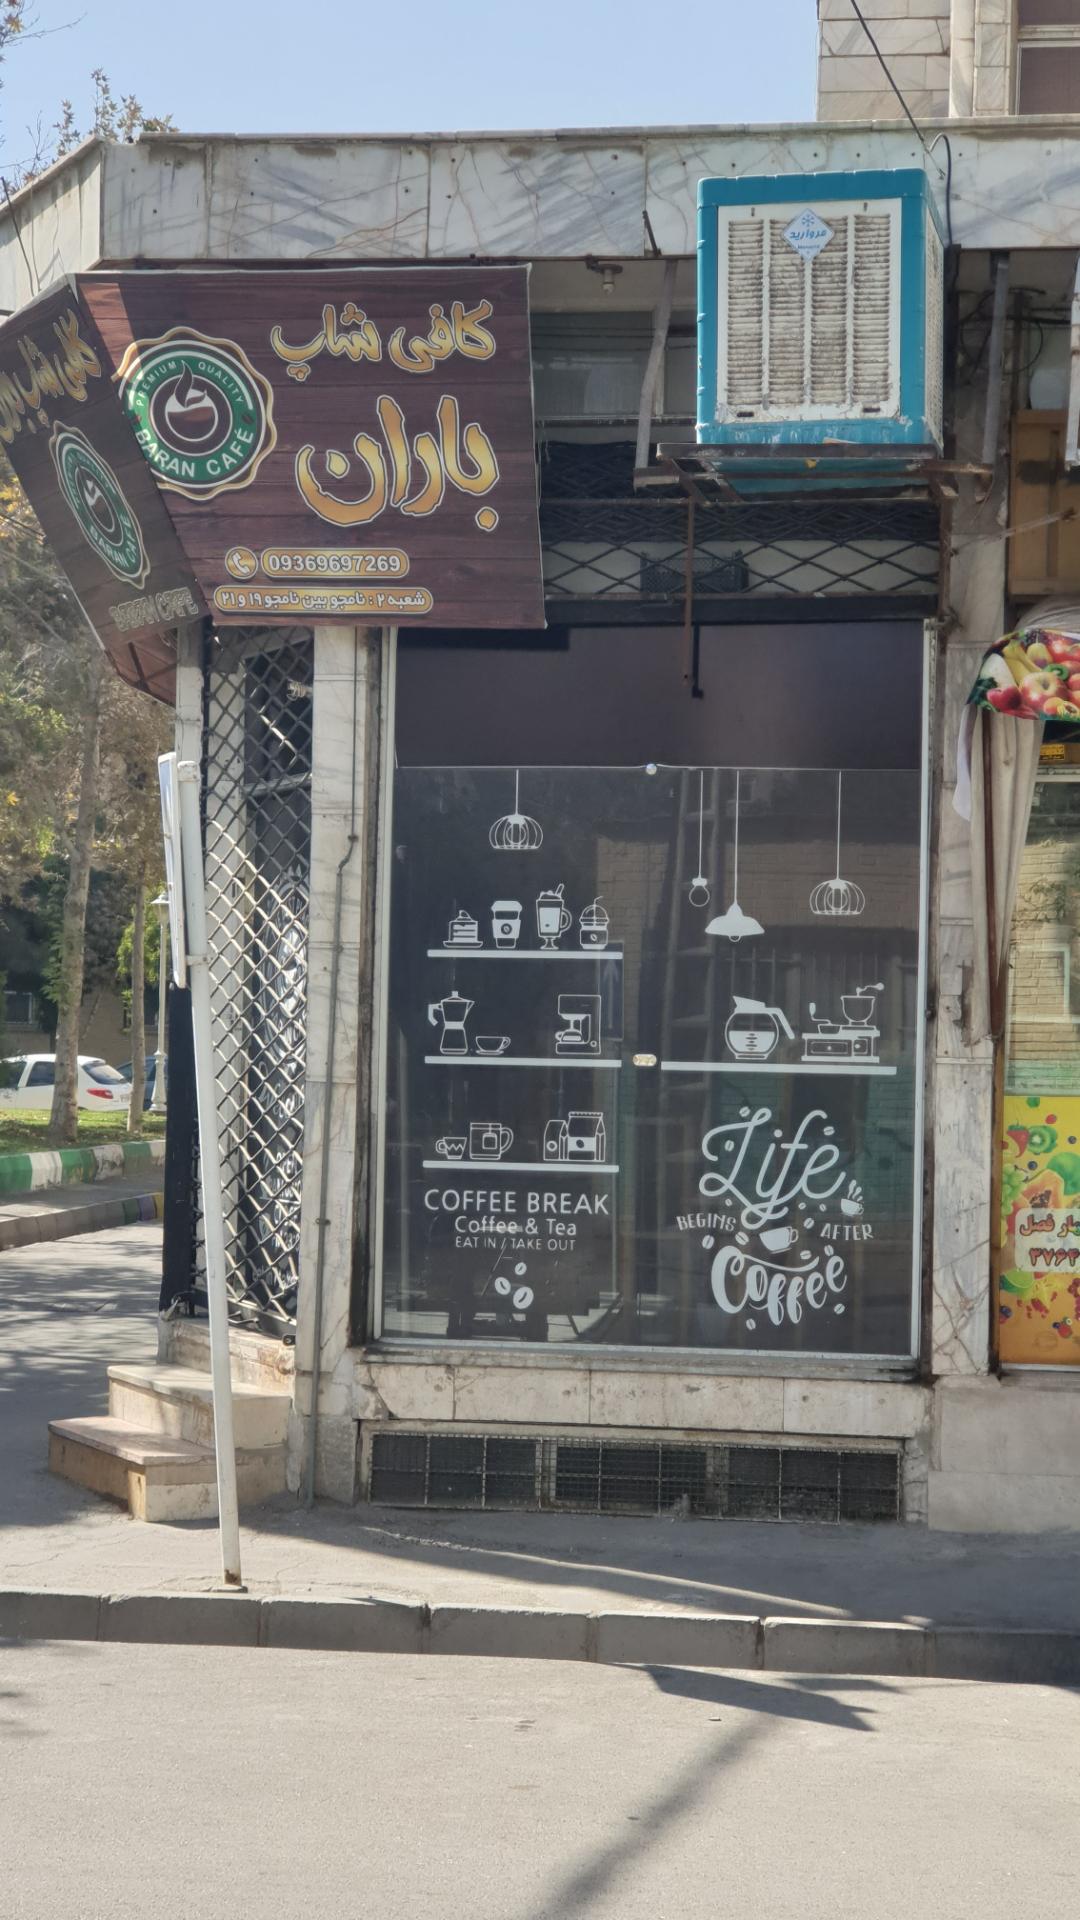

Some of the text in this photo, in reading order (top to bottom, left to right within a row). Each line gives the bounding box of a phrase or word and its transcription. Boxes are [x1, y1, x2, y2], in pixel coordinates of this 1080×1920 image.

[270, 299, 495, 381] کافی شاپ
[136, 361, 244, 407] PREMIUM QUALITY
[136, 428, 195, 478] BARAN
[296, 395, 499, 531] باران
[268, 554, 401, 573] 09369697269
[221, 591, 236, 607] ۲۱
[237, 594, 245, 608] و
[249, 592, 263, 607] ۱۹
[264, 592, 300, 609] نامجو
[302, 594, 326, 610] بین
[331, 591, 365, 610] نامجو
[387, 591, 425, 609] شعبه
[699, 1107, 846, 1230] Life
[424, 1189, 609, 1215] COFFEE BREAK
[455, 1215, 577, 1236] Coffee & Tea
[676, 1212, 874, 1241] BEGINS AFTER
[1020, 1213, 1055, 1236] فصل
[456, 1236, 478, 1248] EAT
[484, 1237, 496, 1249] IN
[511, 1238, 542, 1250] TAKE
[547, 1239, 576, 1251] OUT
[711, 1245, 847, 1326] Coffee
